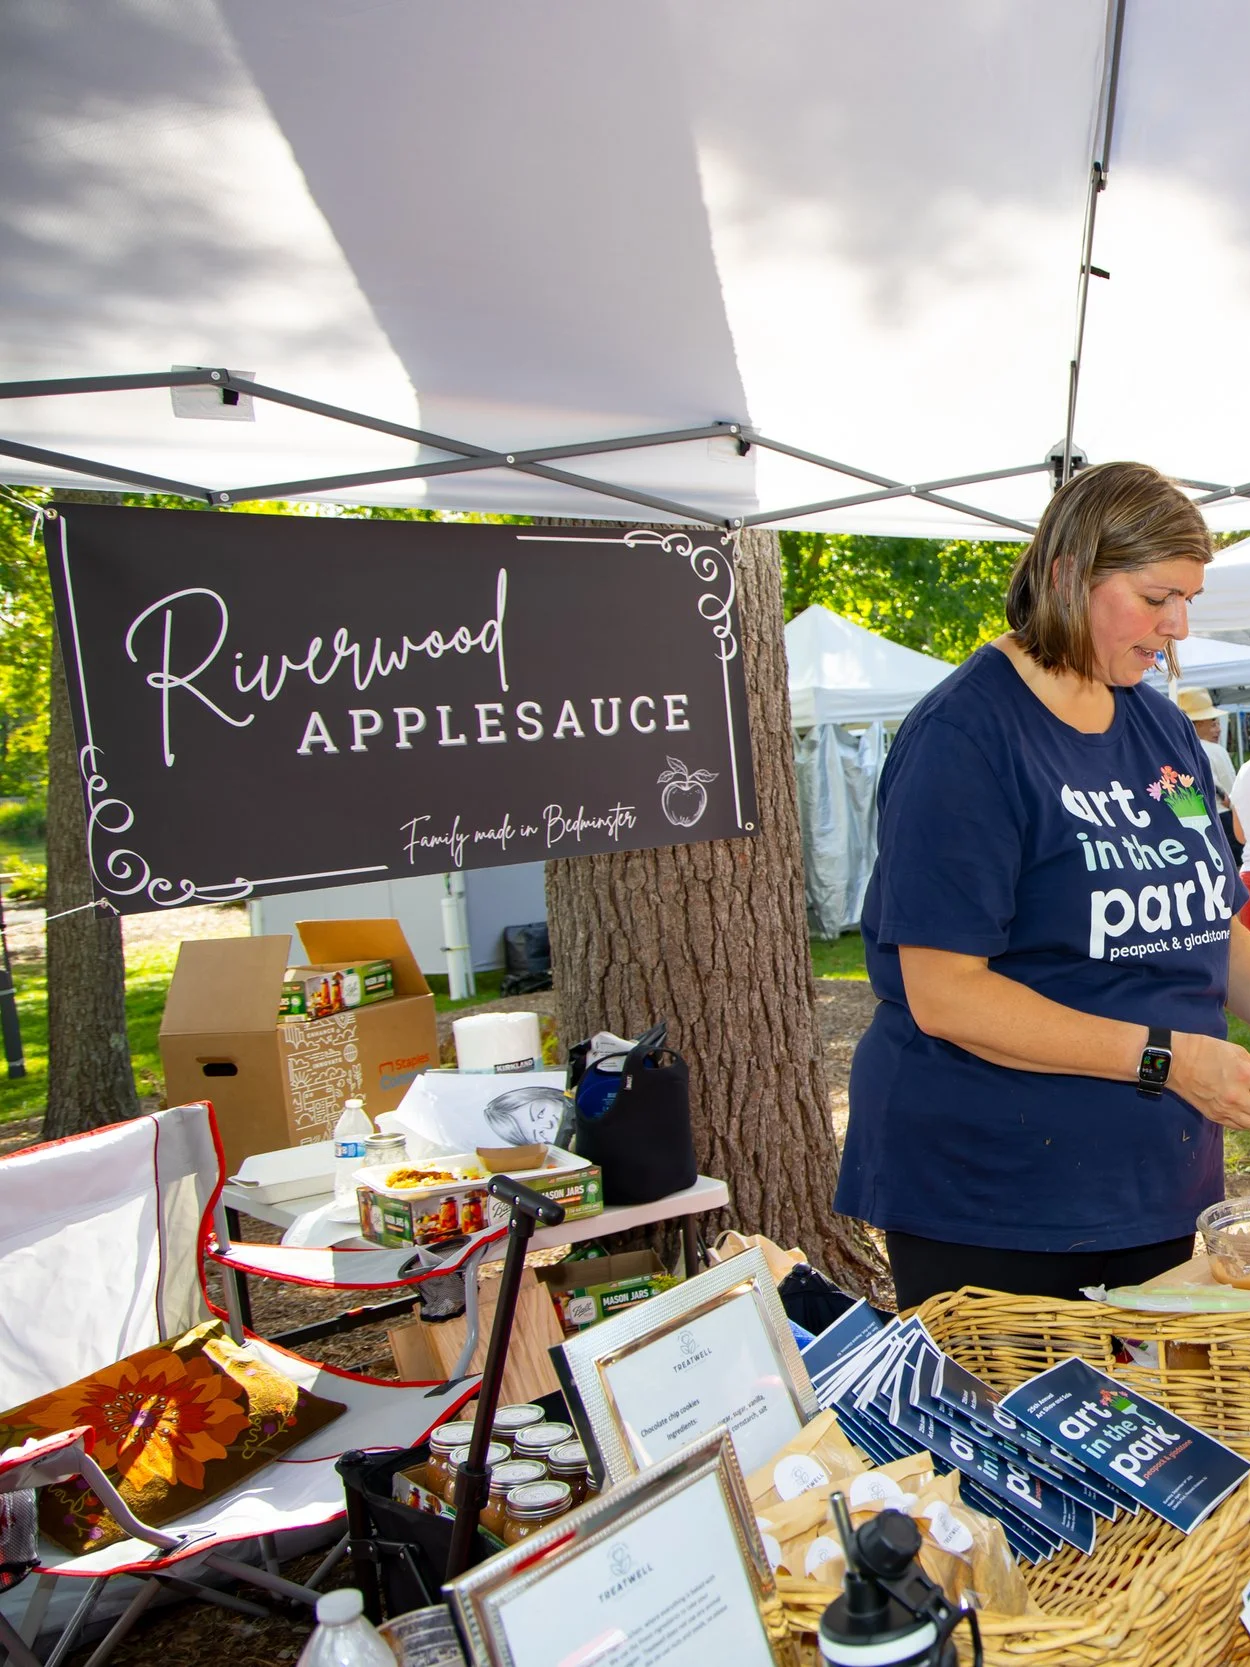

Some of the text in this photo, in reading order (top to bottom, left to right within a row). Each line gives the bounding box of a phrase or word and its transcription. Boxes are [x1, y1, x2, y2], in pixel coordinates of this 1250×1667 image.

[126, 568, 510, 768] Riverwood
[297, 694, 691, 756] APPLESAUCE
[1061, 780, 1150, 829] art
[400, 802, 637, 867] Family made in Bedminster
[1076, 832, 1189, 871] in the
[1089, 860, 1232, 959] park
[1110, 938, 1170, 962] peapack
[1172, 937, 1181, 950] &
[395, 1053, 430, 1071] Staples
[496, 1059, 534, 1073] KIRKLAND
[542, 1184, 585, 1200] ASON JARS
[602, 1288, 649, 1307] MASON JARS
[673, 1347, 713, 1374] TREATWELL
[640, 1398, 700, 1438] Chocolate chip cookies
[666, 1418, 698, 1442] Ingredients:
[1059, 1400, 1112, 1440] art
[1081, 1439, 1106, 1459] in
[1103, 1418, 1138, 1441] the
[1108, 1424, 1181, 1487] park
[599, 1563, 654, 1603] TREATWELL
